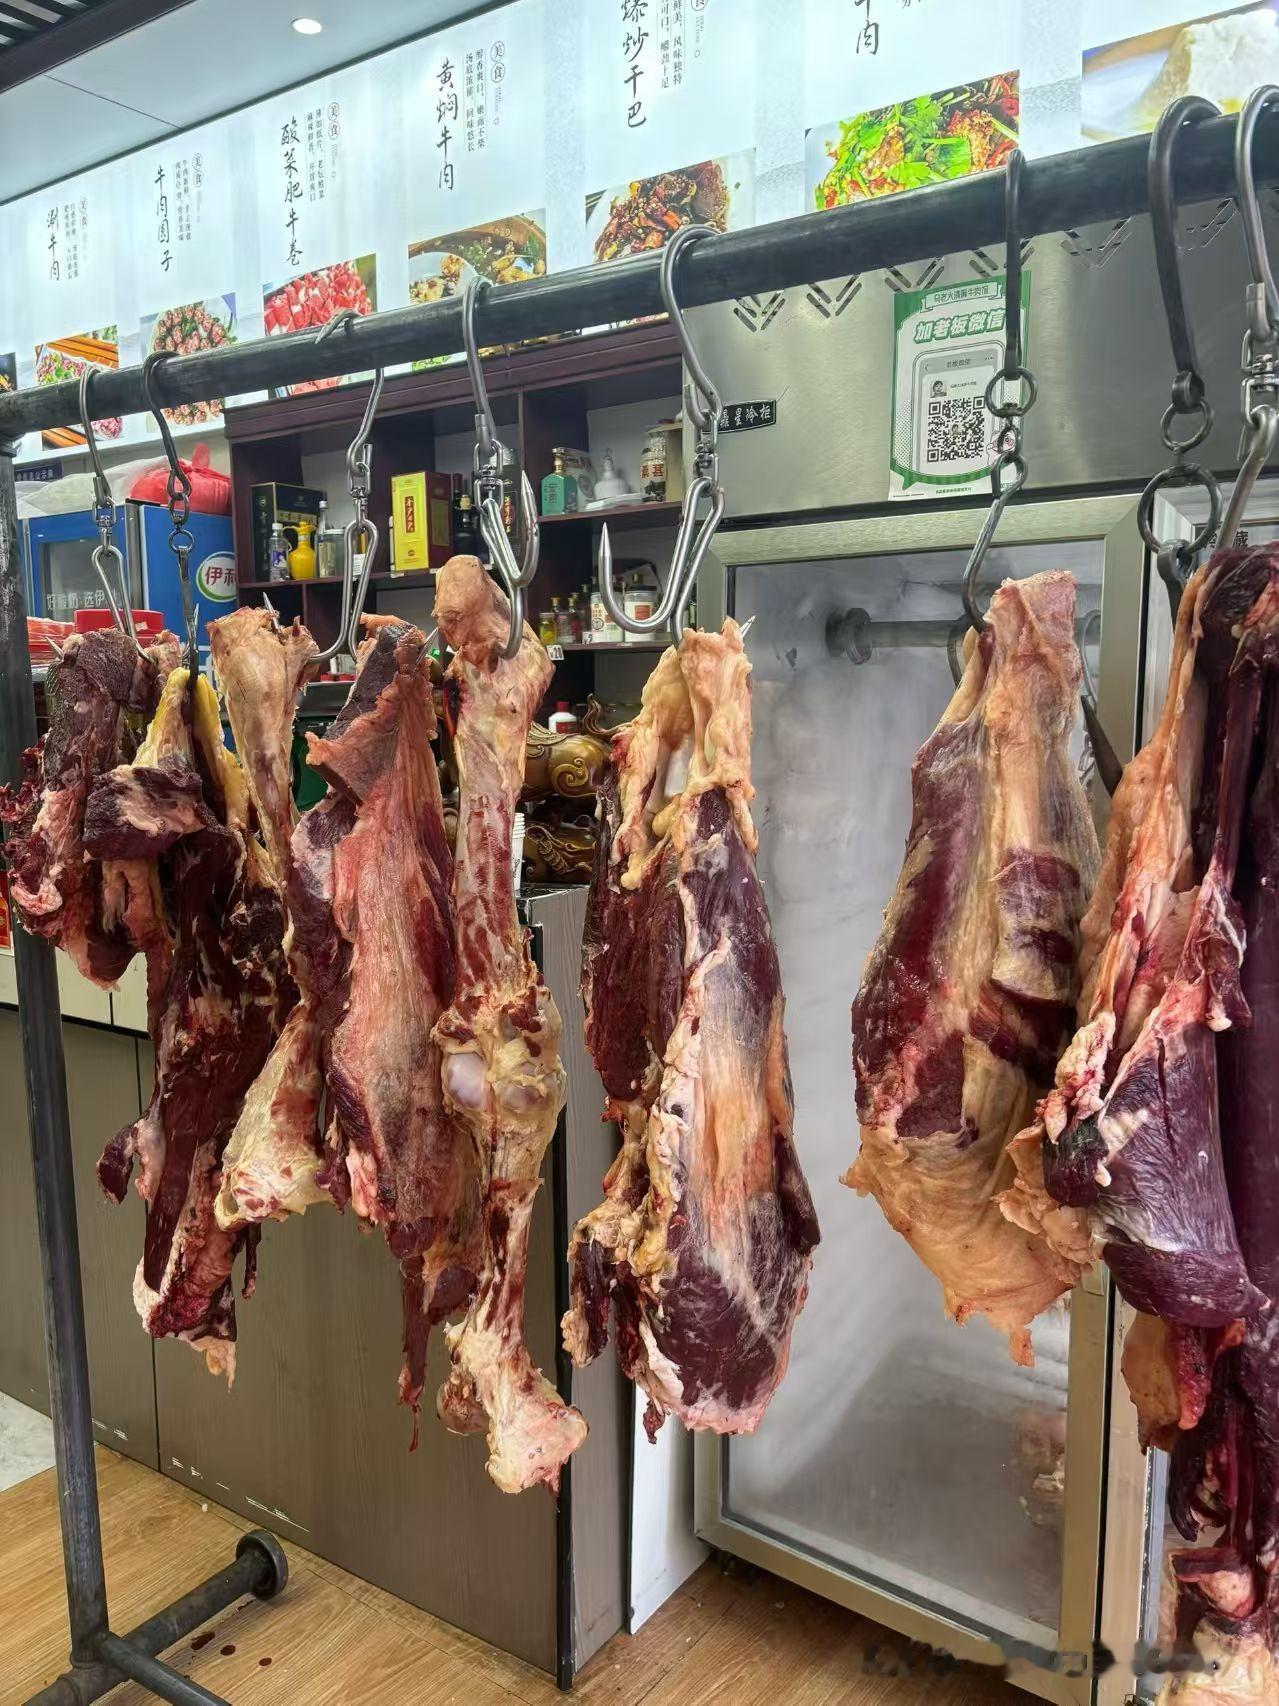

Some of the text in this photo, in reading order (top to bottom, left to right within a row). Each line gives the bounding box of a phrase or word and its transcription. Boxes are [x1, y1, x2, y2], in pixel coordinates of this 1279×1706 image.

[436, 56, 459, 190] 黄焖牛肉
[46, 206, 60, 281] 涮牛肉
[155, 164, 173, 271] 牛肉圆子
[280, 116, 303, 266] 酸菜肥牛卷
[914, 308, 1005, 344] 加老板微信
